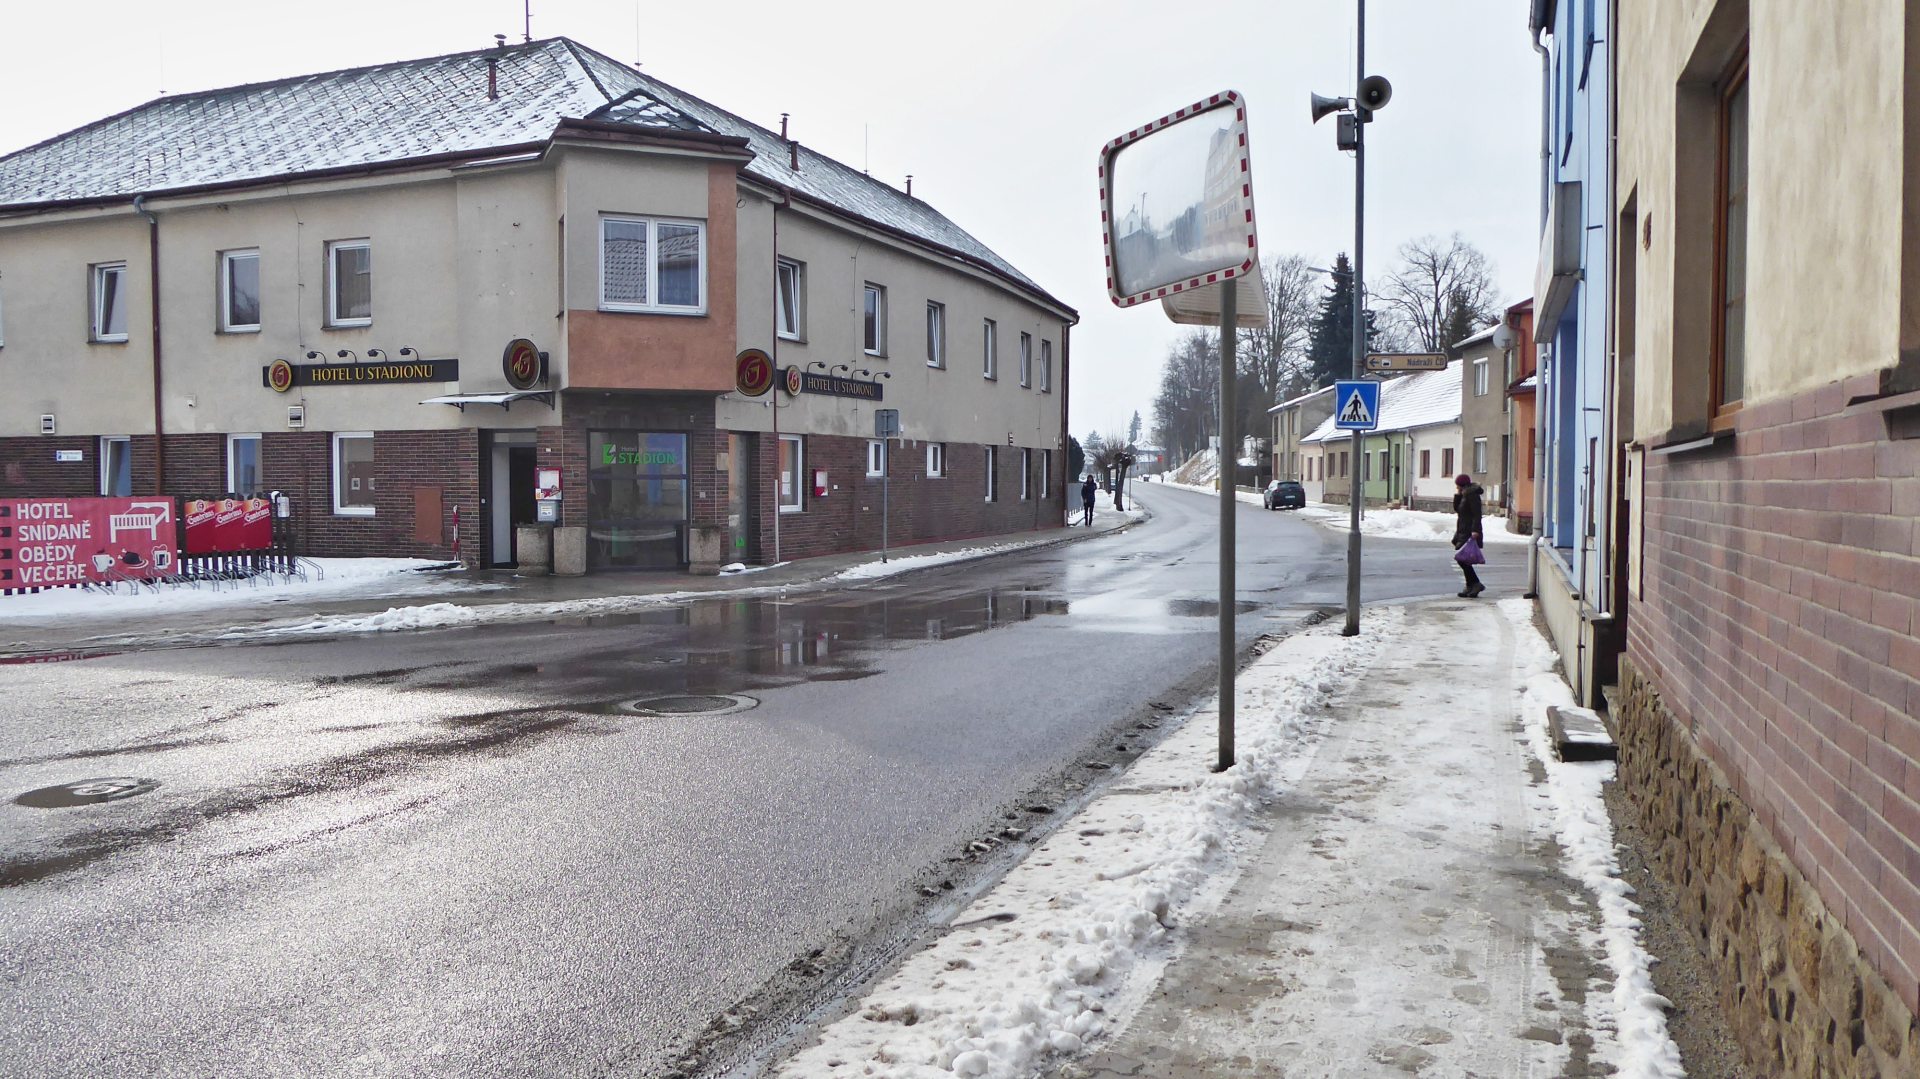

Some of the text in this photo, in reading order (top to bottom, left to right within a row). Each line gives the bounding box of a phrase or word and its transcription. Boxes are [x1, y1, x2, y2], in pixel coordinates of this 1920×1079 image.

[312, 364, 433, 382] HOTEL U STADIONU
[807, 377, 874, 397] HOTEL U STADIONU
[618, 452, 675, 464] STADION
[17, 503, 74, 520] HOTEL
[18, 520, 91, 541] SNÍDANĚ
[19, 543, 77, 563] OBĚDY
[19, 562, 87, 583] VEČEŘE
